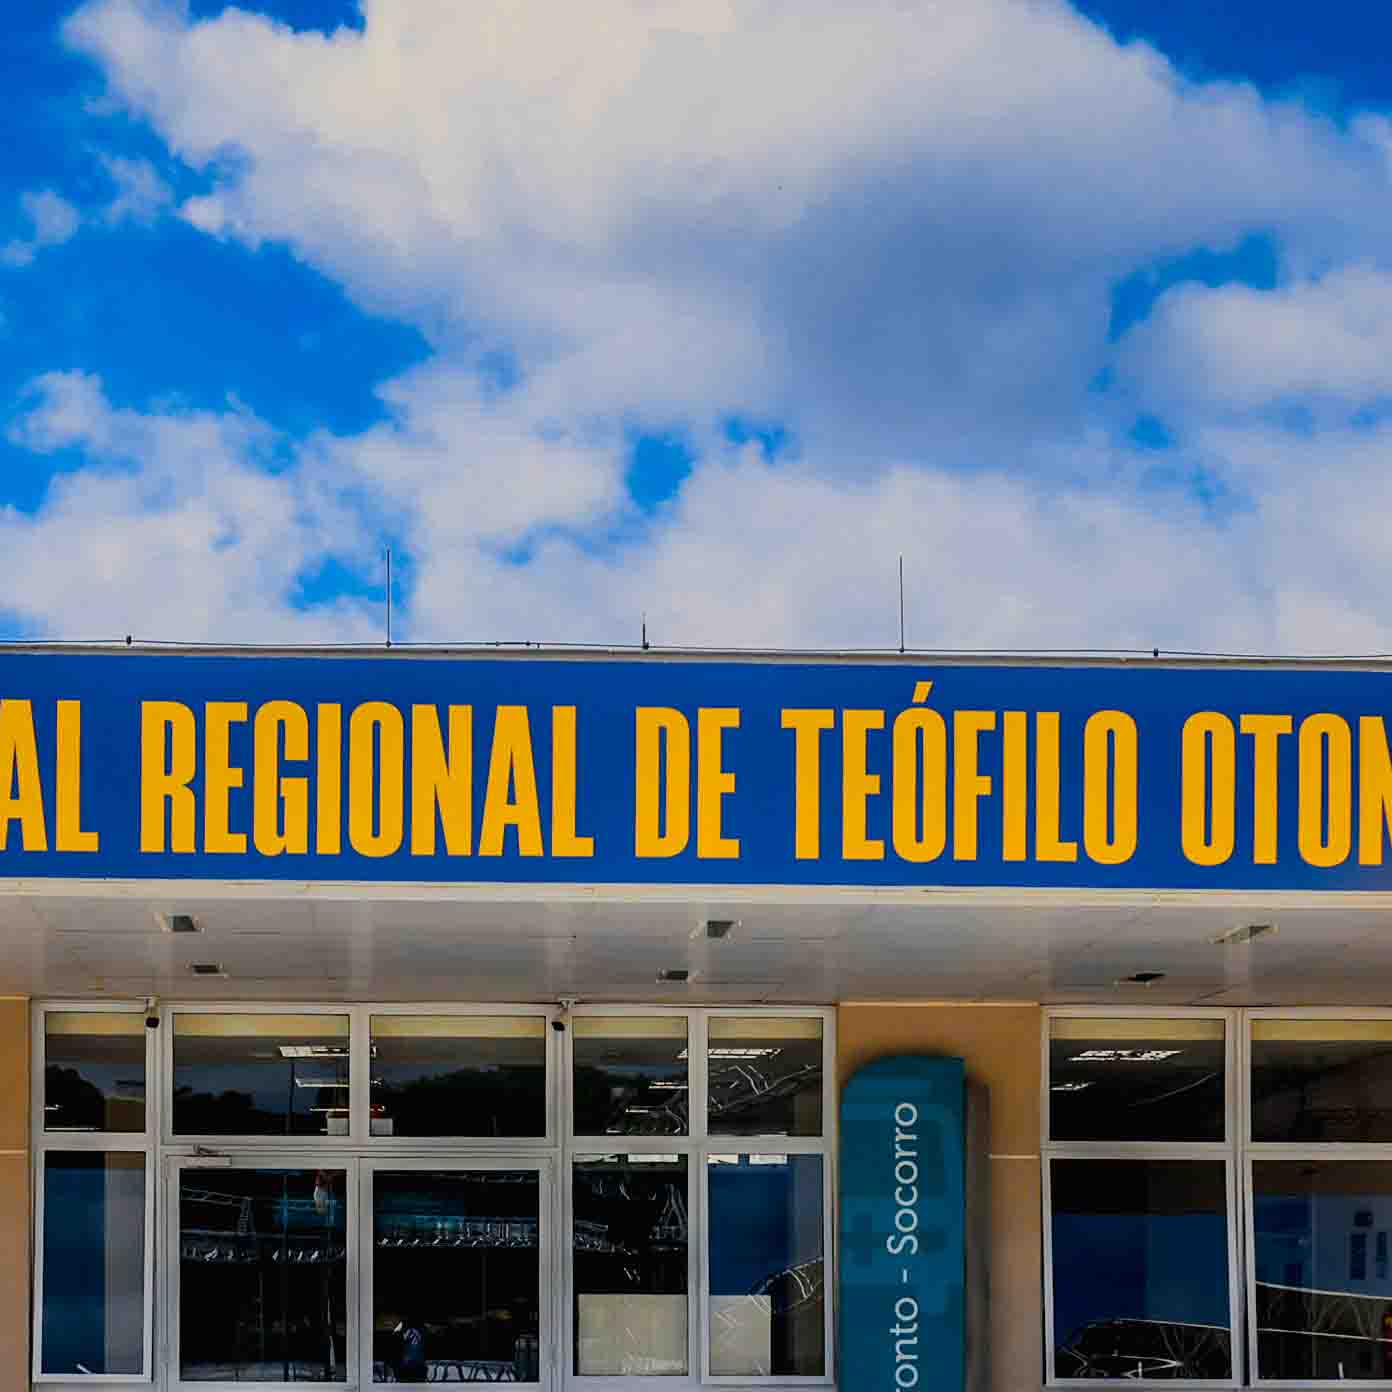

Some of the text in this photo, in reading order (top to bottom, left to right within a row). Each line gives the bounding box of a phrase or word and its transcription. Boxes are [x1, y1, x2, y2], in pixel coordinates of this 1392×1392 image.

[141, 701, 594, 857] REGIONAL
[636, 707, 740, 859] DE
[782, 681, 1137, 865] TEÓFILO
[886, 1102, 918, 1255] Socorro
